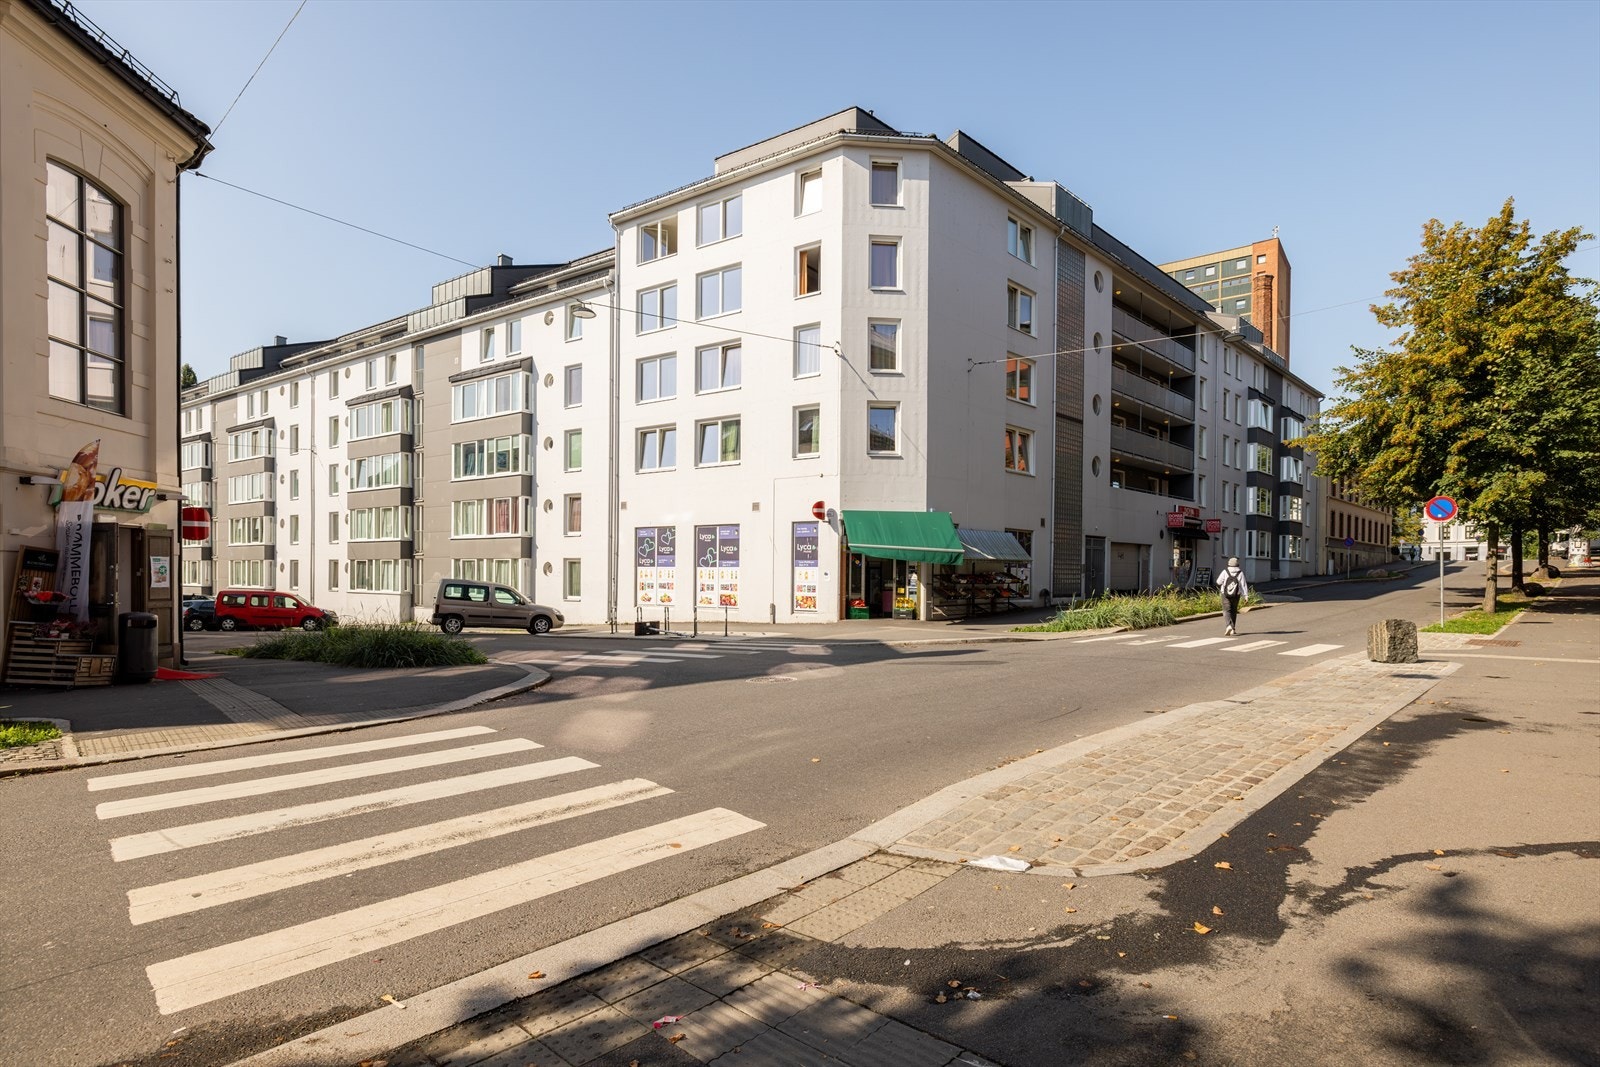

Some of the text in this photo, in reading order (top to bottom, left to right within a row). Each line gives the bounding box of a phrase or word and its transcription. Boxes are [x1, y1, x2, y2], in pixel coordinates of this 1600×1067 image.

[94, 467, 156, 511] oker
[720, 545, 734, 553] Lyca
[797, 543, 812, 552] Lyca
[69, 514, 83, 615] ØMMEBOLL
